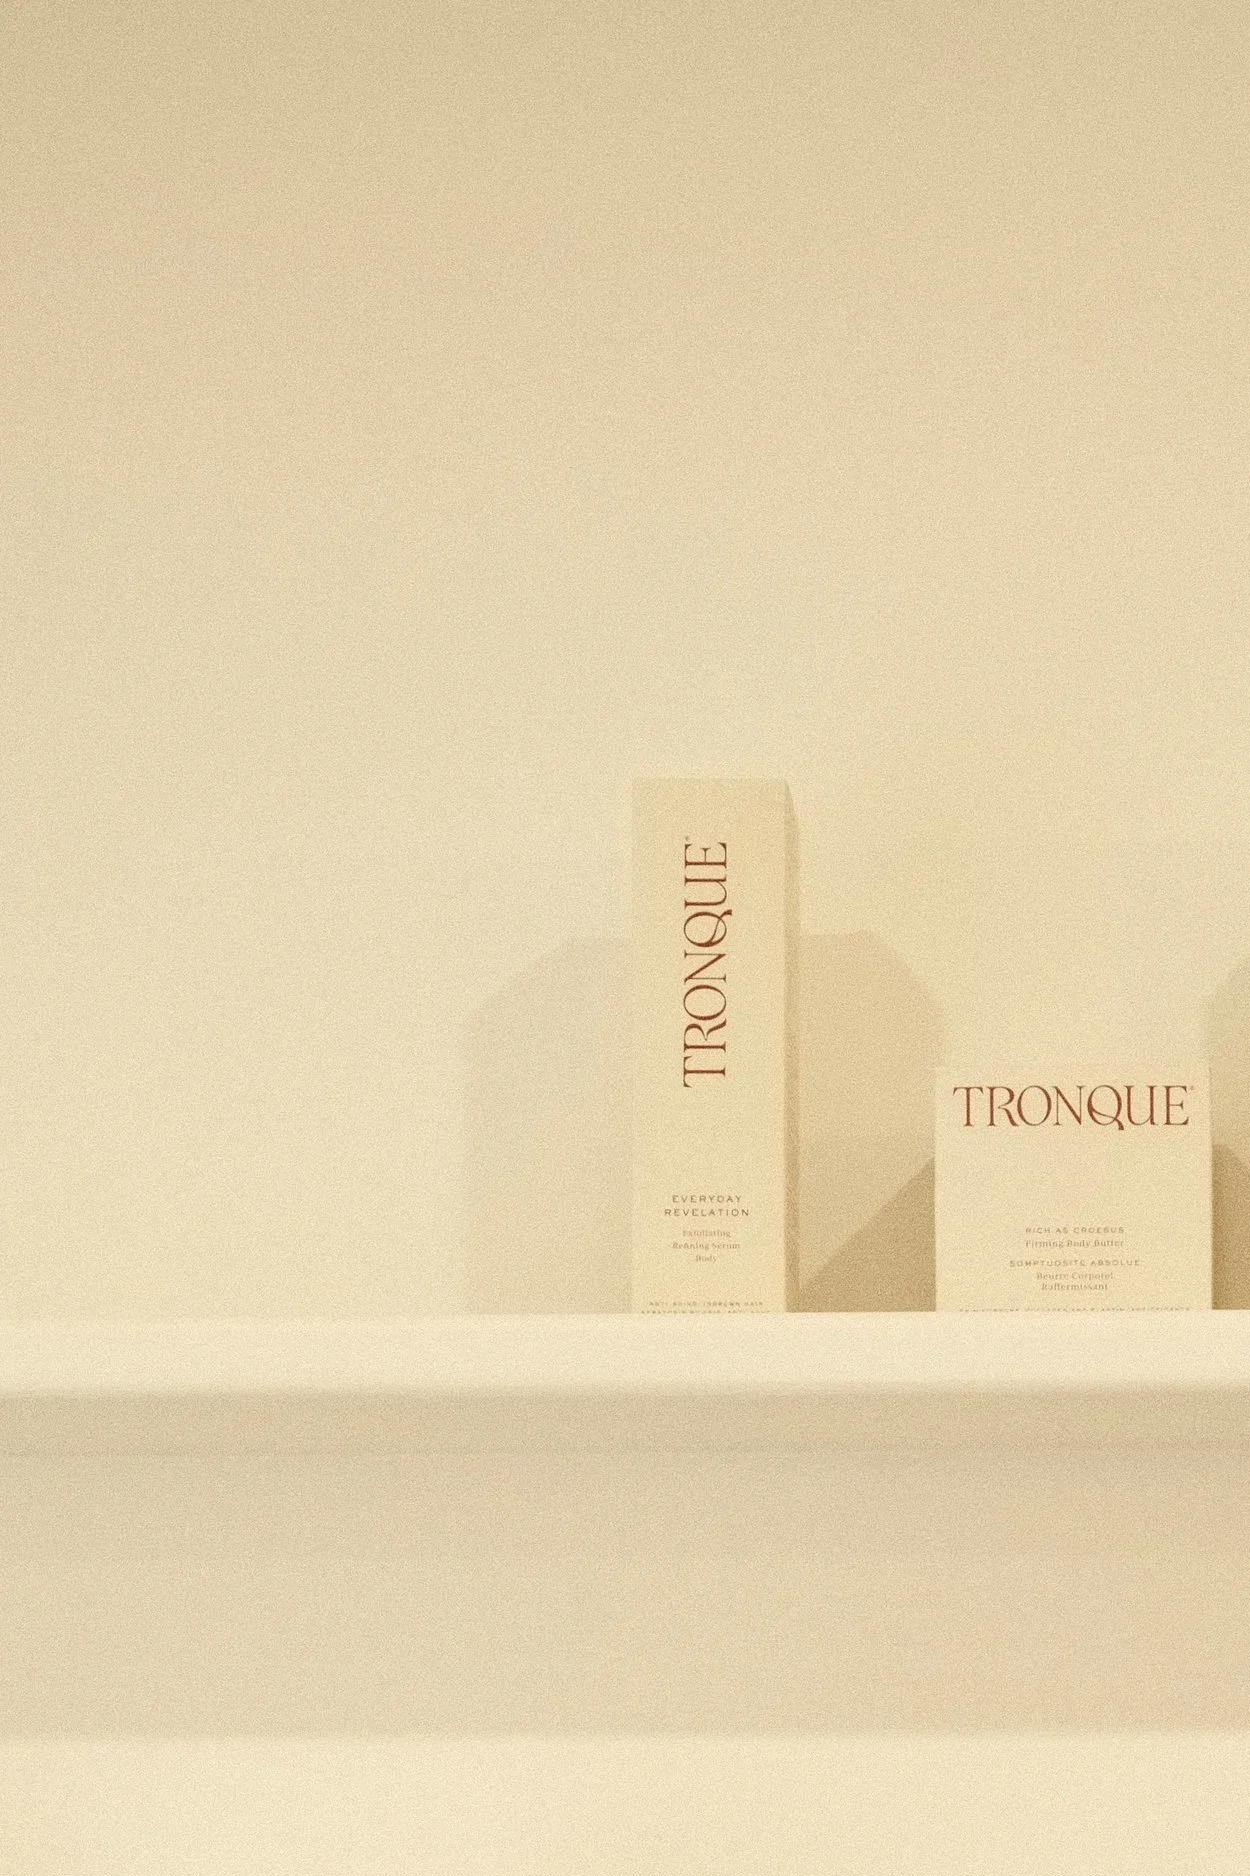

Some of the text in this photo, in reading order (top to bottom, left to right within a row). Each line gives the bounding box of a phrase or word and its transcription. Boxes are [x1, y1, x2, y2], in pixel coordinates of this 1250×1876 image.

[682, 842, 733, 1089] TRONQUE
[953, 1084, 1190, 1131] TRONQUE
[664, 1208, 750, 1217] REVELATION
[671, 1195, 742, 1203] EVERYDAY
